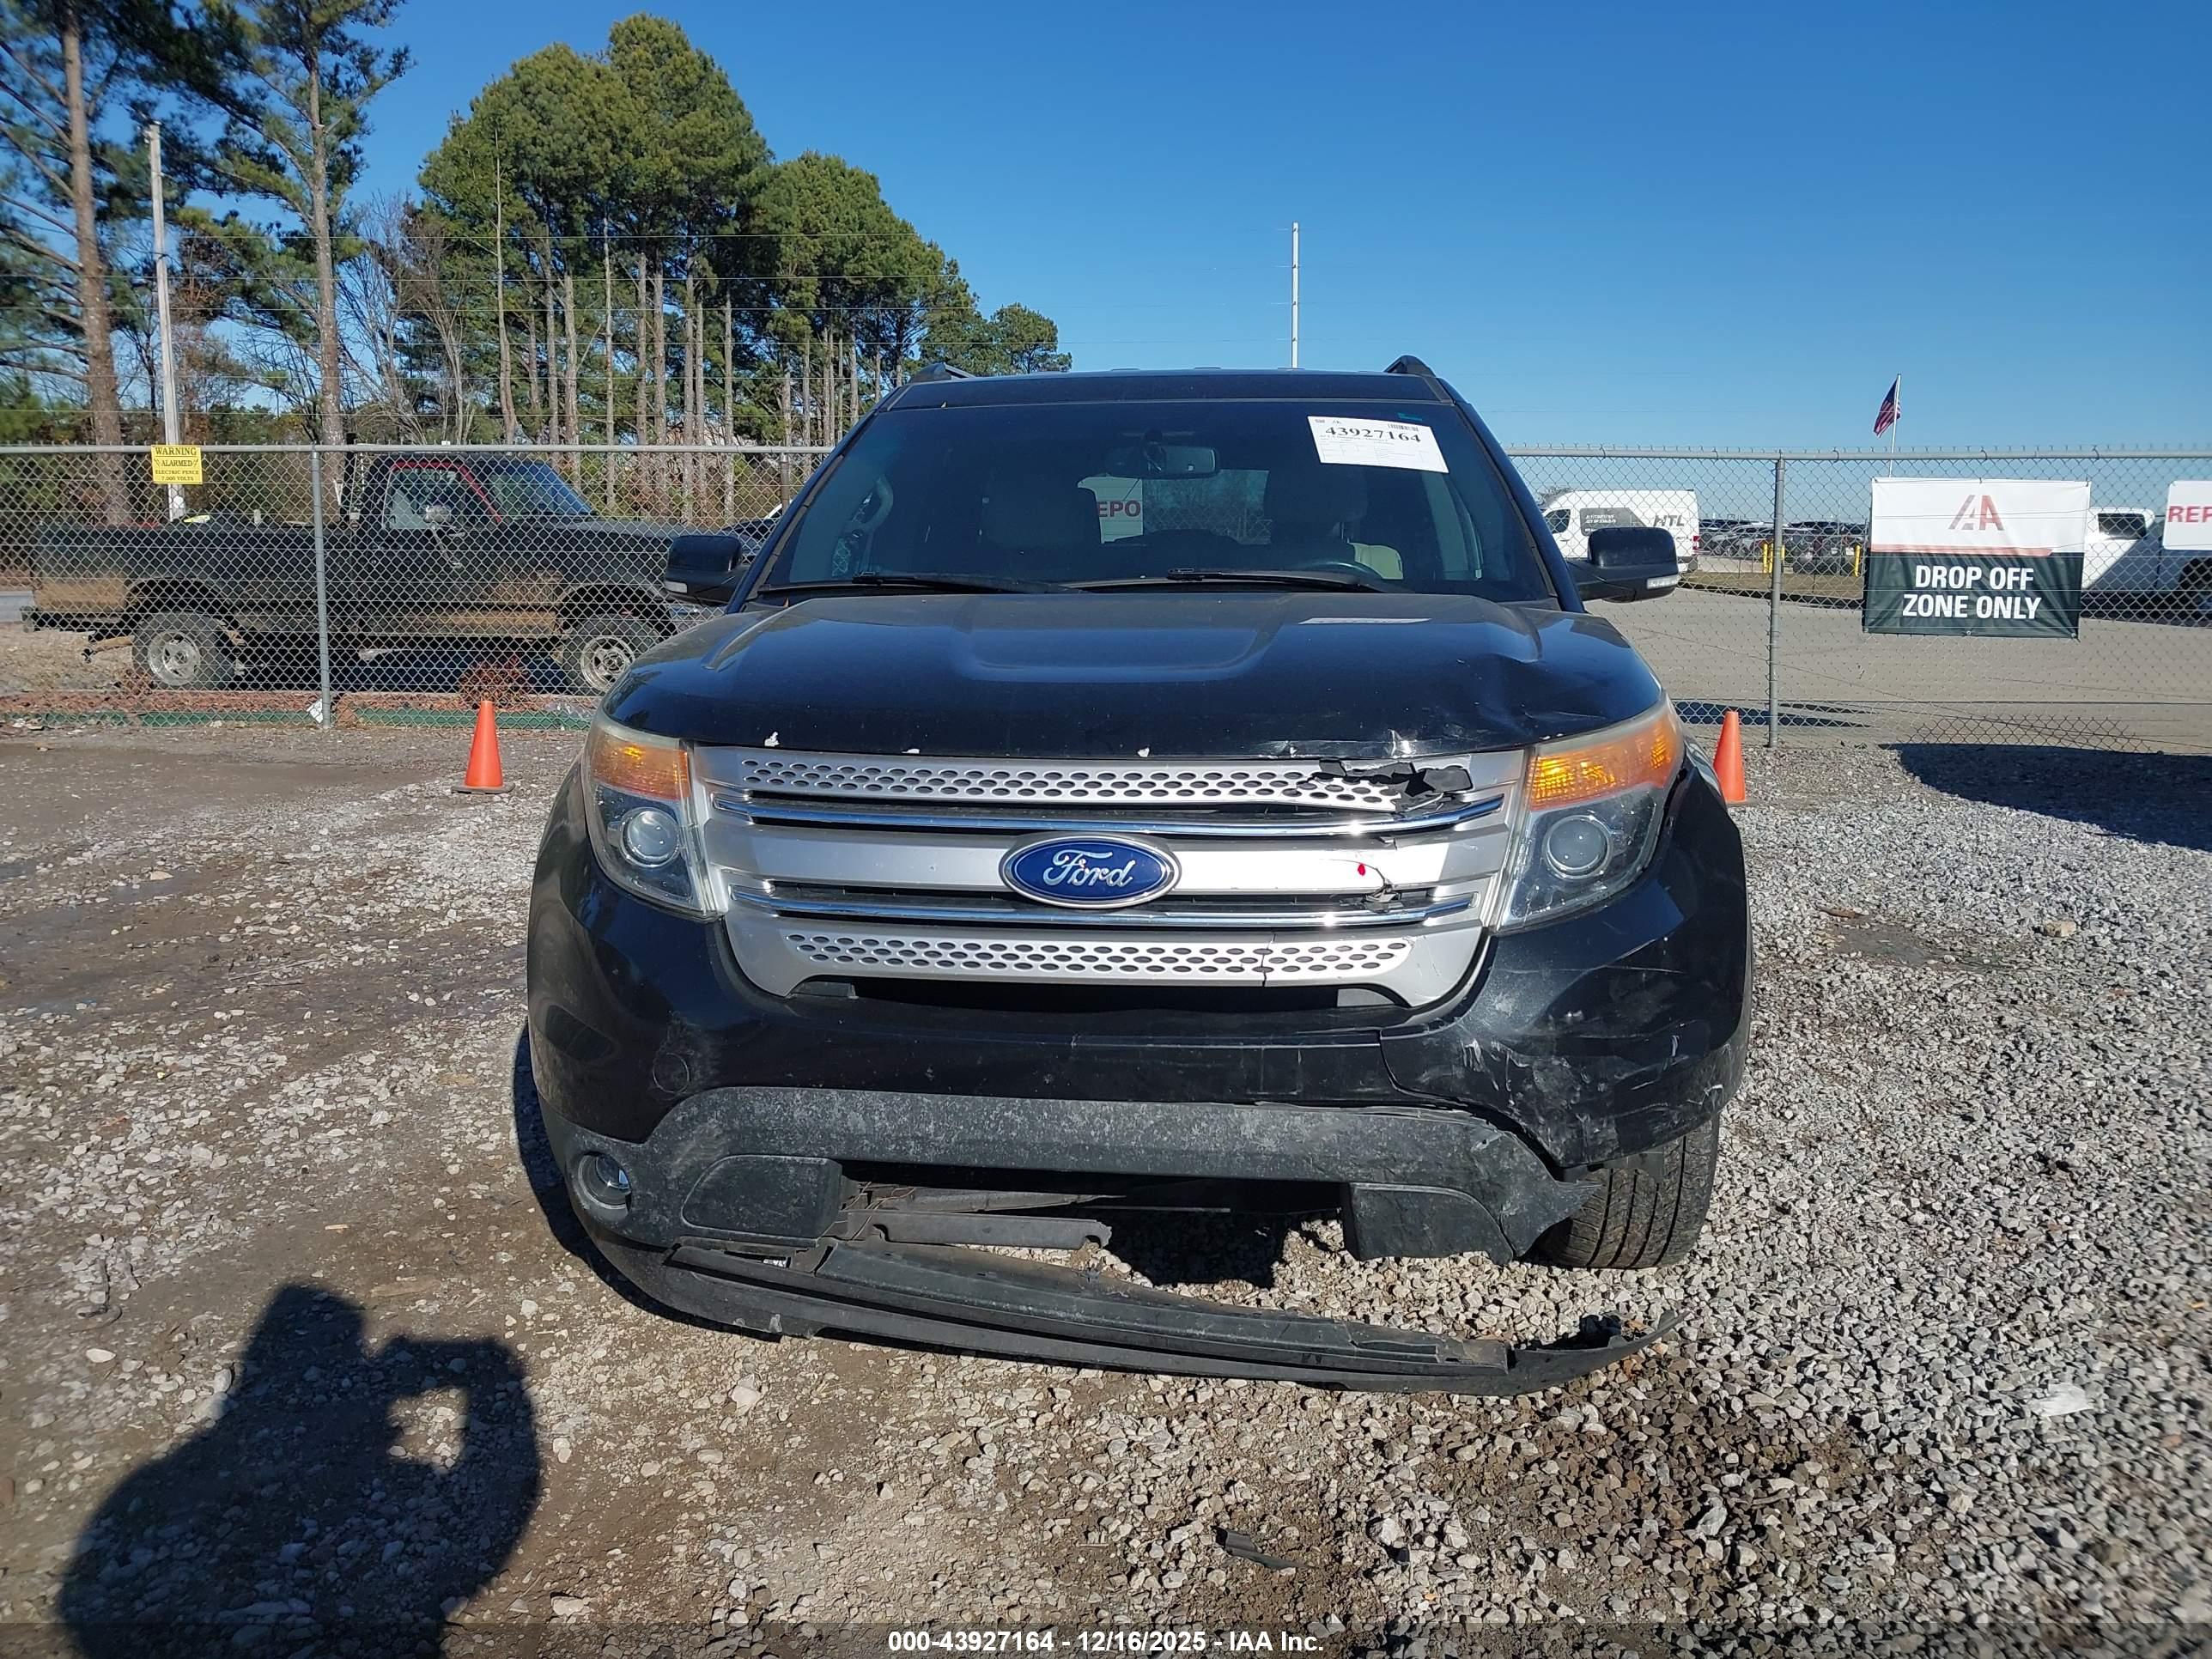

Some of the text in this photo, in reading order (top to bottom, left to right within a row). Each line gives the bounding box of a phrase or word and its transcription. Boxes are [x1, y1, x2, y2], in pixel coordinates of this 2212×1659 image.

[1325, 427, 1421, 442] 43927164
[155, 447, 197, 455] WARNING
[1915, 565, 2034, 591] DROP OFF
[1902, 593, 2042, 620] ZONE ONLY
[1042, 848, 1136, 887] Ford
